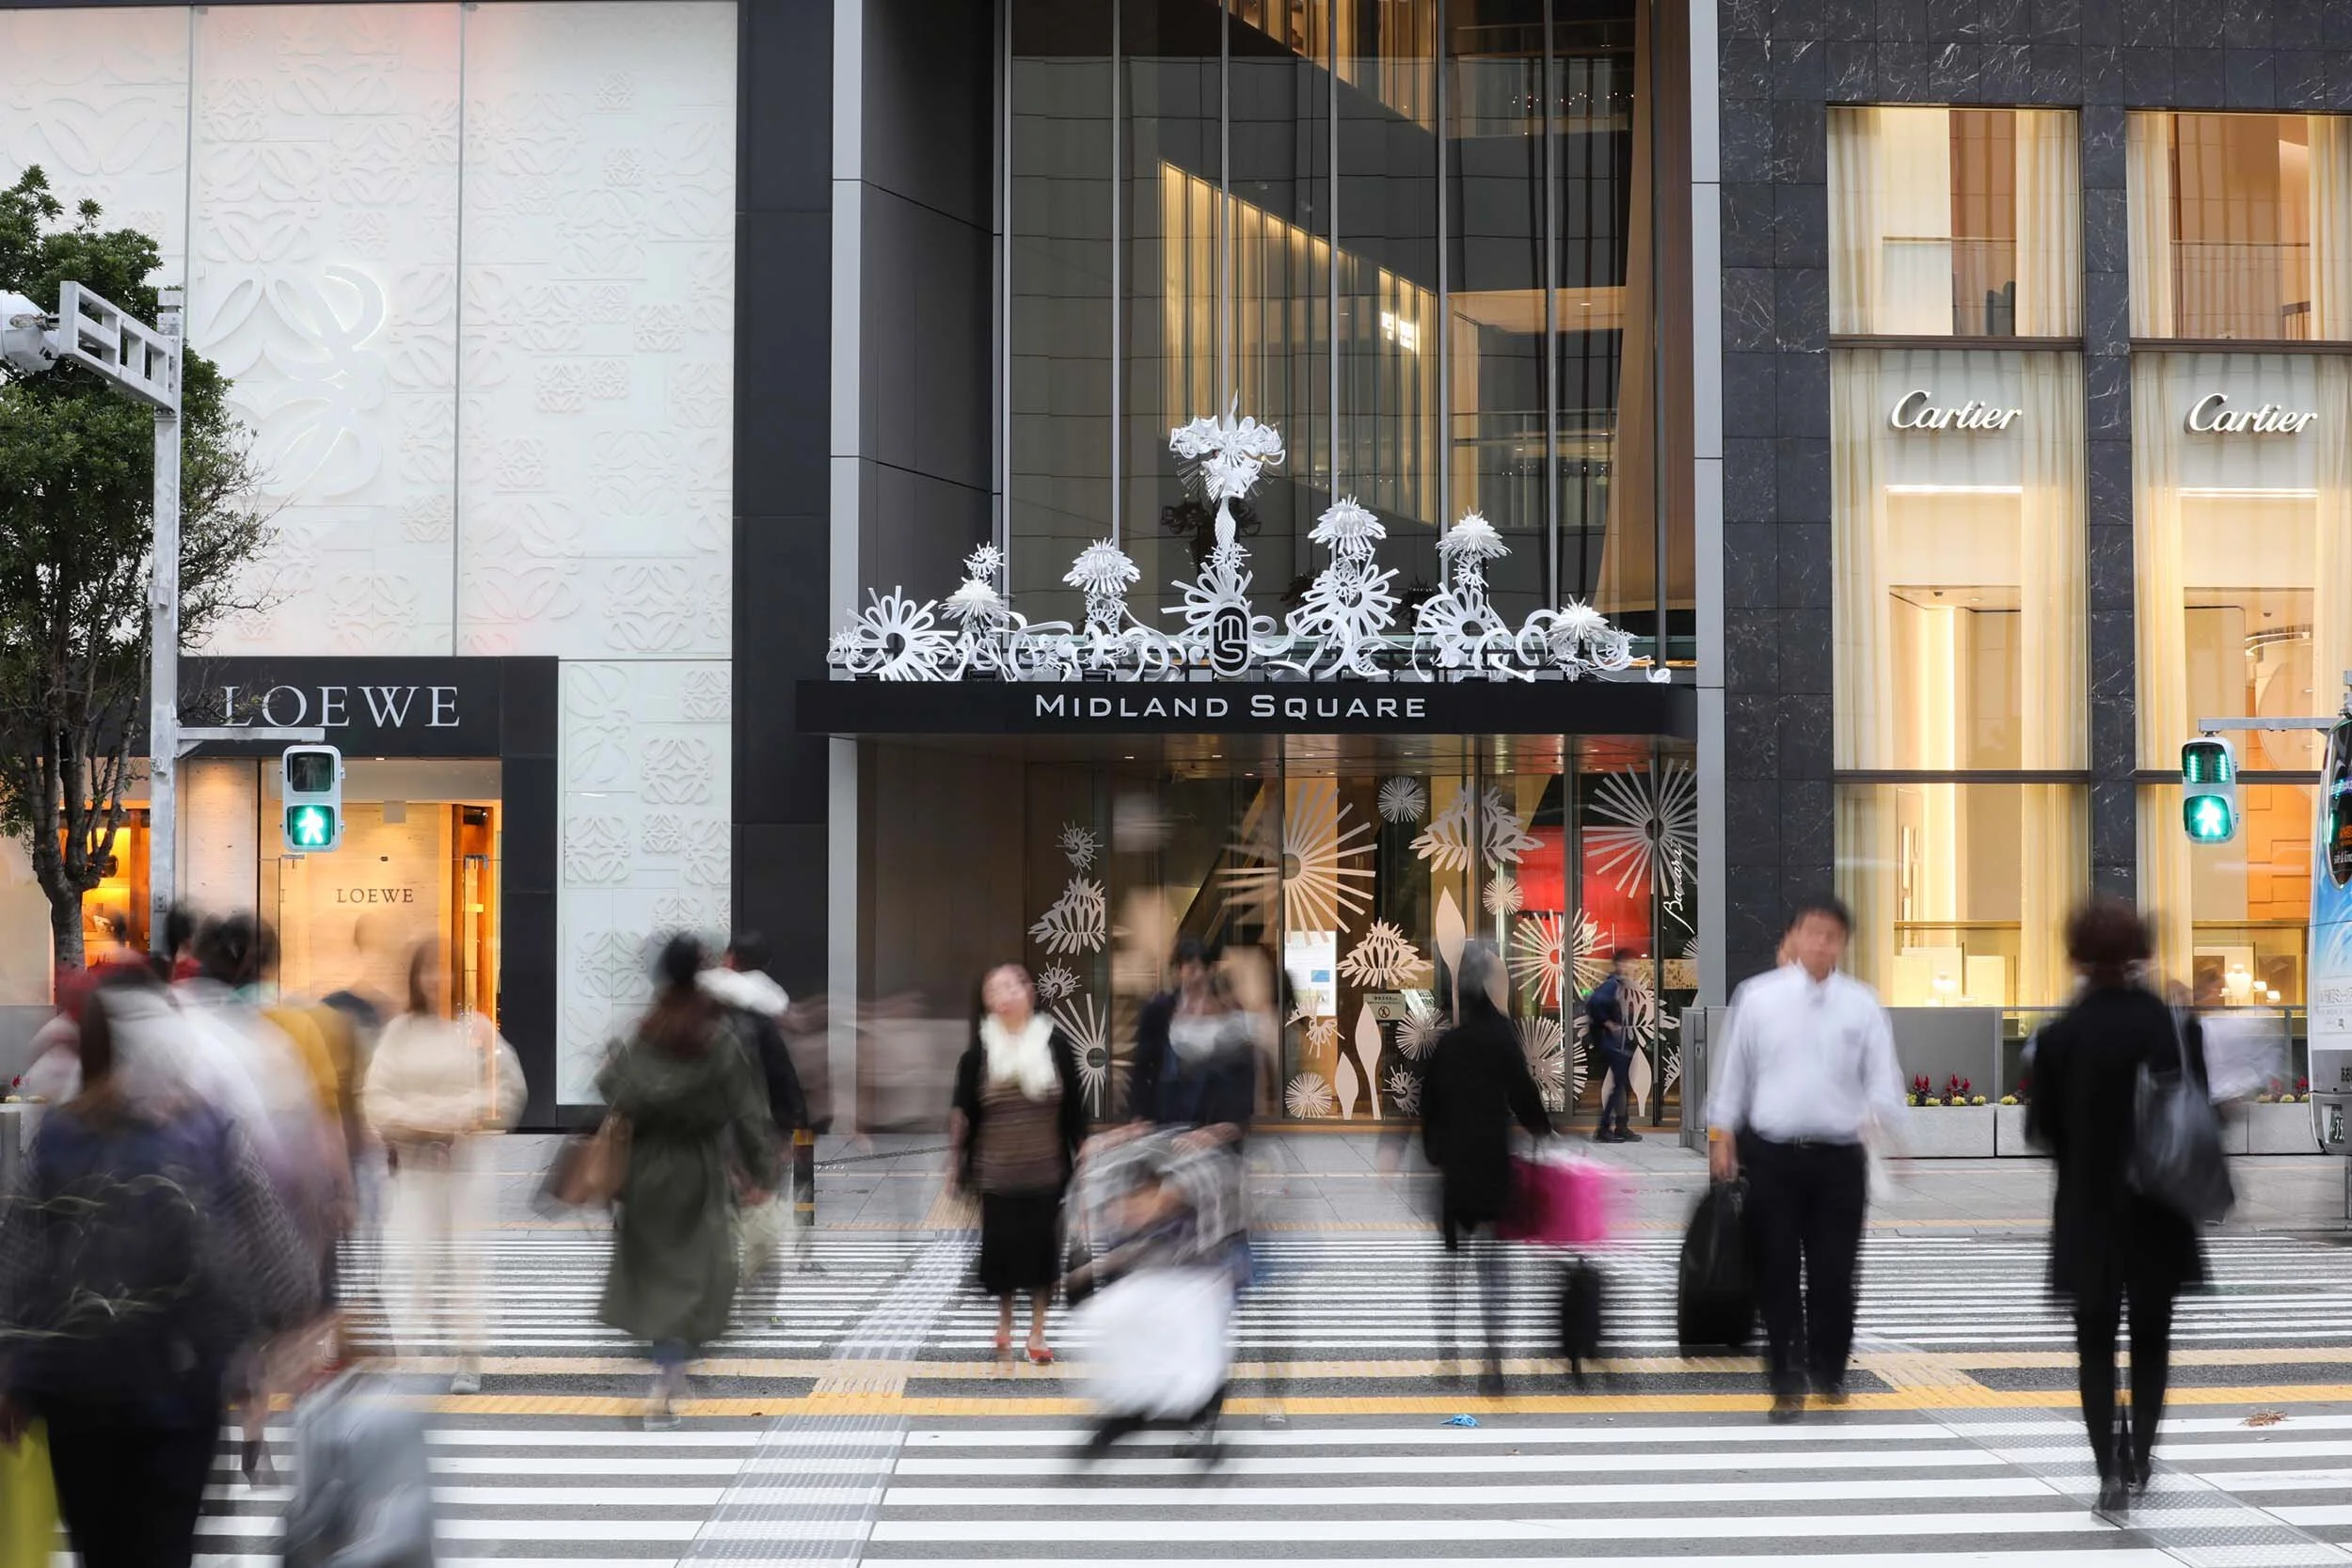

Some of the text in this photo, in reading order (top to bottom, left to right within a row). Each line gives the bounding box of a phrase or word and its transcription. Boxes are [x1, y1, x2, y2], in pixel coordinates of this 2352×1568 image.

[1891, 389, 2023, 430] Cartier
[2189, 392, 2318, 433] Cartier
[220, 685, 460, 728] LOEWE
[1035, 694, 1426, 721] MIDLAND SQUARE
[336, 888, 414, 903] LOEWE
[1662, 838, 1696, 939] Baara
